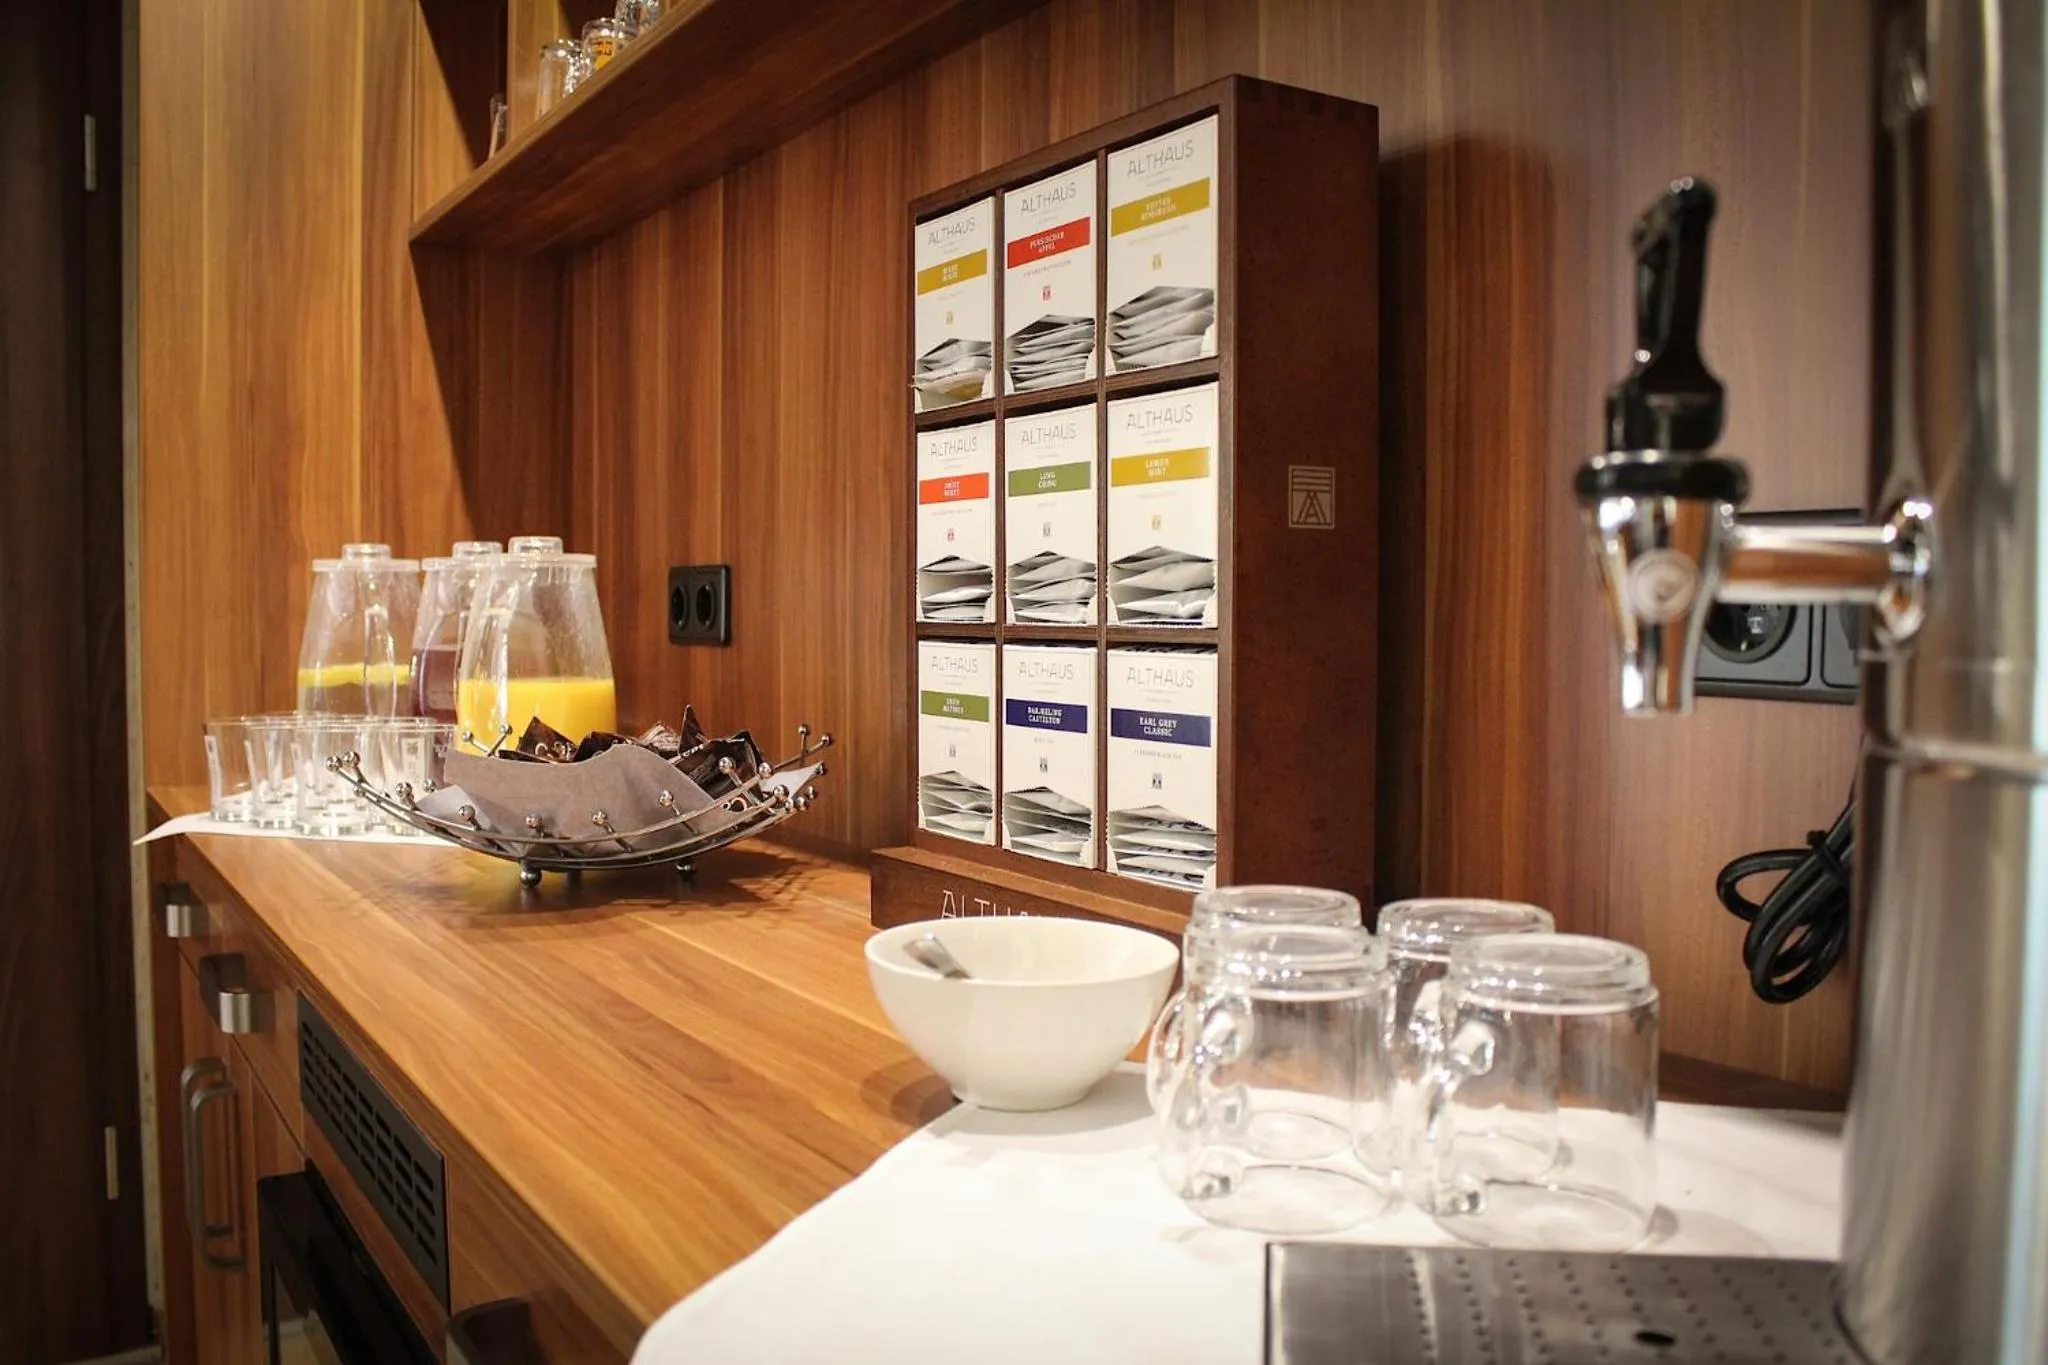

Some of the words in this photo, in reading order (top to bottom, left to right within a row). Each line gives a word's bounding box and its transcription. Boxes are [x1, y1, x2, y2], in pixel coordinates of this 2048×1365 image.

[1127, 140, 1194, 177] ALTHAUS
[1021, 182, 1077, 213] ALTHAUS
[928, 217, 976, 247] ALTHAUS
[1127, 404, 1193, 430] ALTHAUS
[1021, 423, 1077, 445] ALTHAUS
[930, 437, 978, 458] ALTHAUS
[932, 656, 979, 674] ALTHAUS
[1018, 661, 1074, 681] ALTHAUS
[1127, 667, 1194, 688] ALTHAUS
[1139, 717, 1156, 727] EARL
[1158, 718, 1177, 728] GREY
[1143, 726, 1173, 737] CLASSIC
